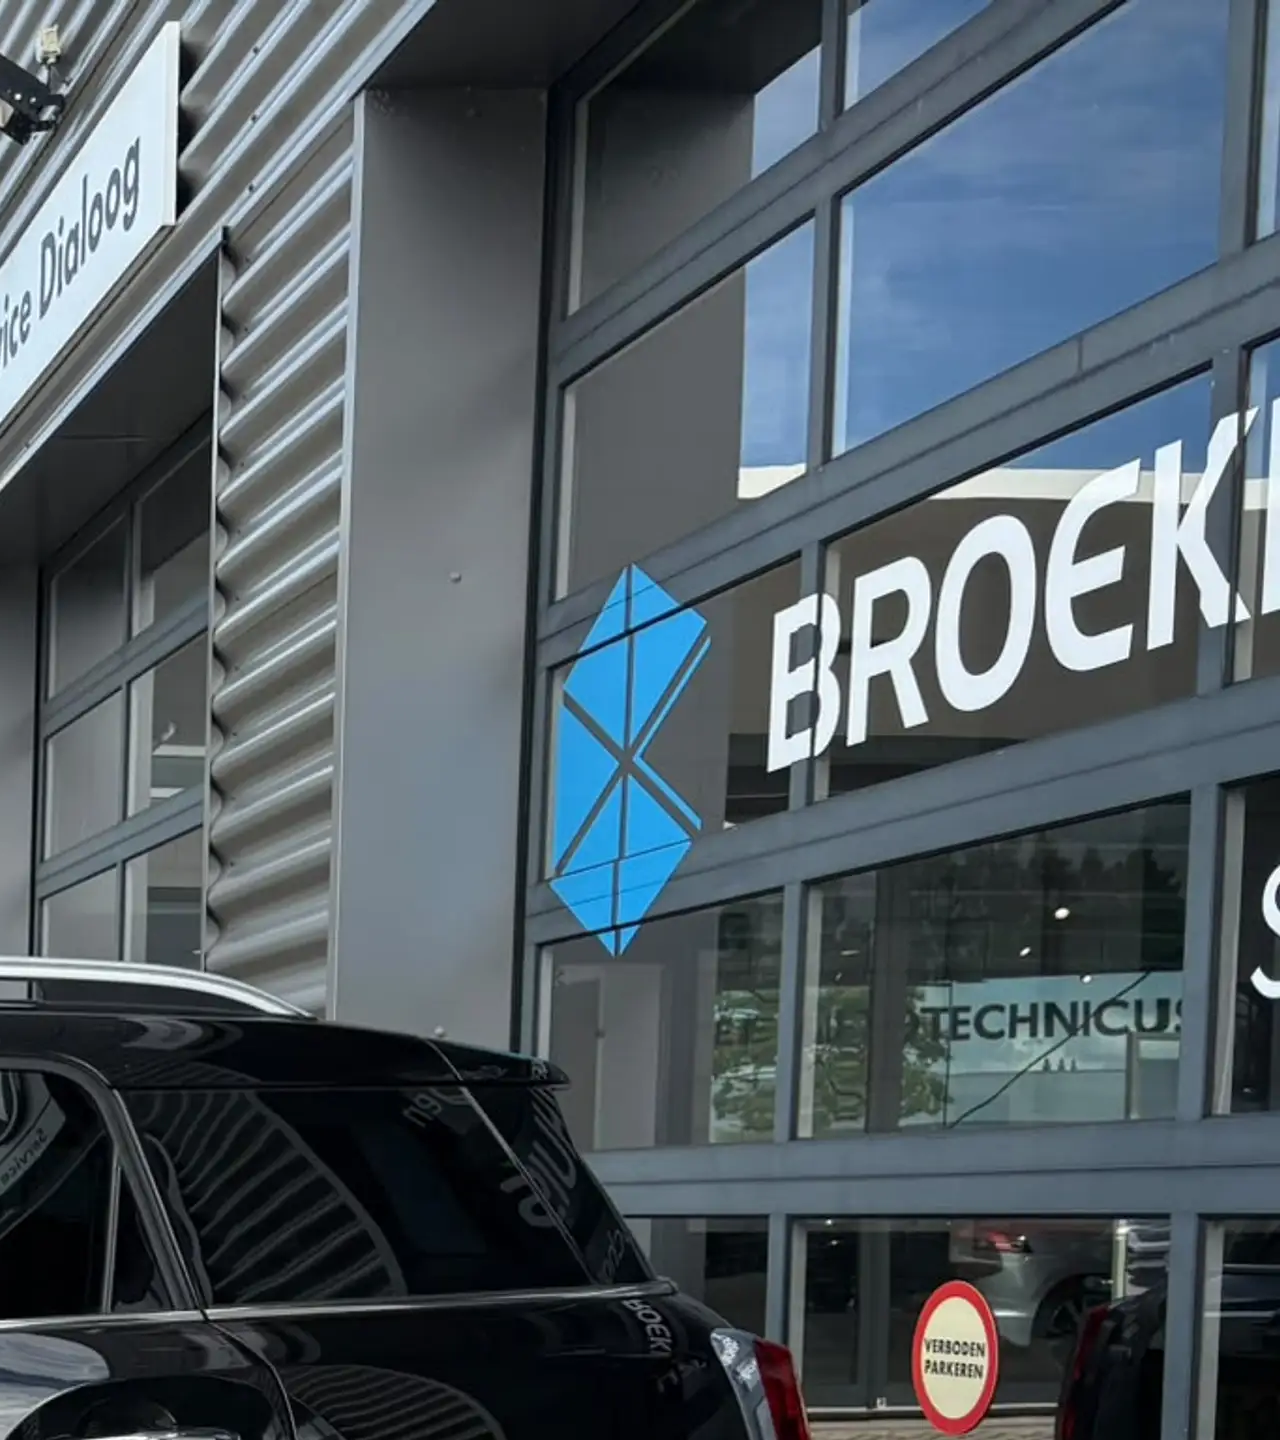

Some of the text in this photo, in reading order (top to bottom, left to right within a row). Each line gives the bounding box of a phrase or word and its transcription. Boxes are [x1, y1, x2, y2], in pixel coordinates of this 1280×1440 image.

[39, 136, 140, 321] Dialoog
[924, 1338, 986, 1357] VERBODEN
[924, 1359, 984, 1379] PARKEREN
